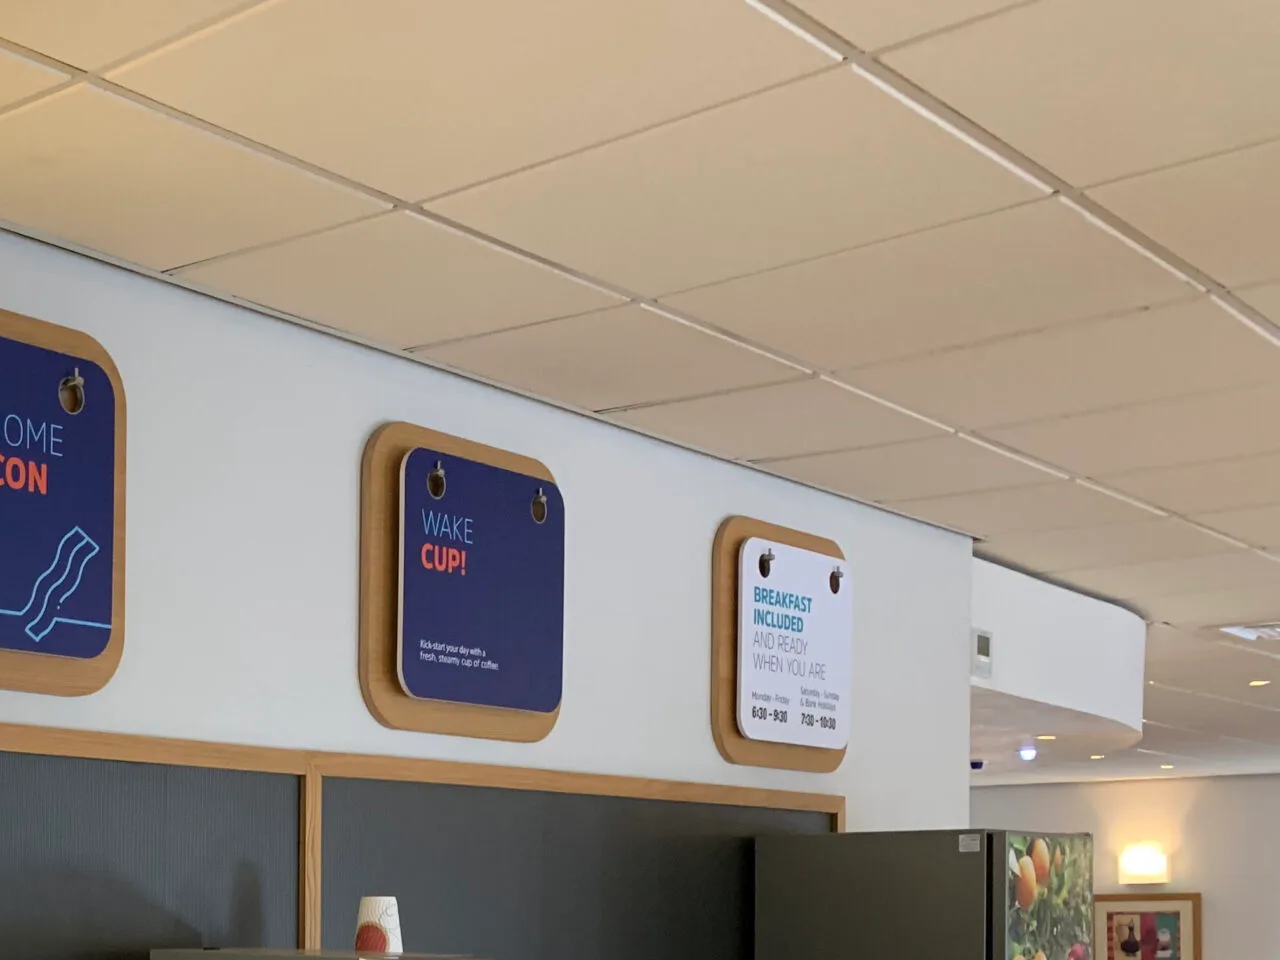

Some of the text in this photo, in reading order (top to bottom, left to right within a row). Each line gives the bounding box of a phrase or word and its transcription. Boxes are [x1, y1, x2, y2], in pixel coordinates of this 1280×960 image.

[422, 508, 474, 545] WAKE
[421, 543, 466, 576] CUP!
[754, 586, 812, 614] BREAKFAST
[754, 610, 803, 633] INCLUDED
[446, 644, 459, 654] your
[459, 645, 469, 656] day
[753, 631, 808, 656] AND READY
[461, 658, 472, 667] cup
[473, 659, 480, 667] of
[753, 653, 826, 681] WHEN YOU ARE
[752, 706, 767, 720] 6:30
[774, 709, 787, 723] 9:30
[801, 713, 814, 727] 7:30
[820, 716, 836, 730] 10:30
